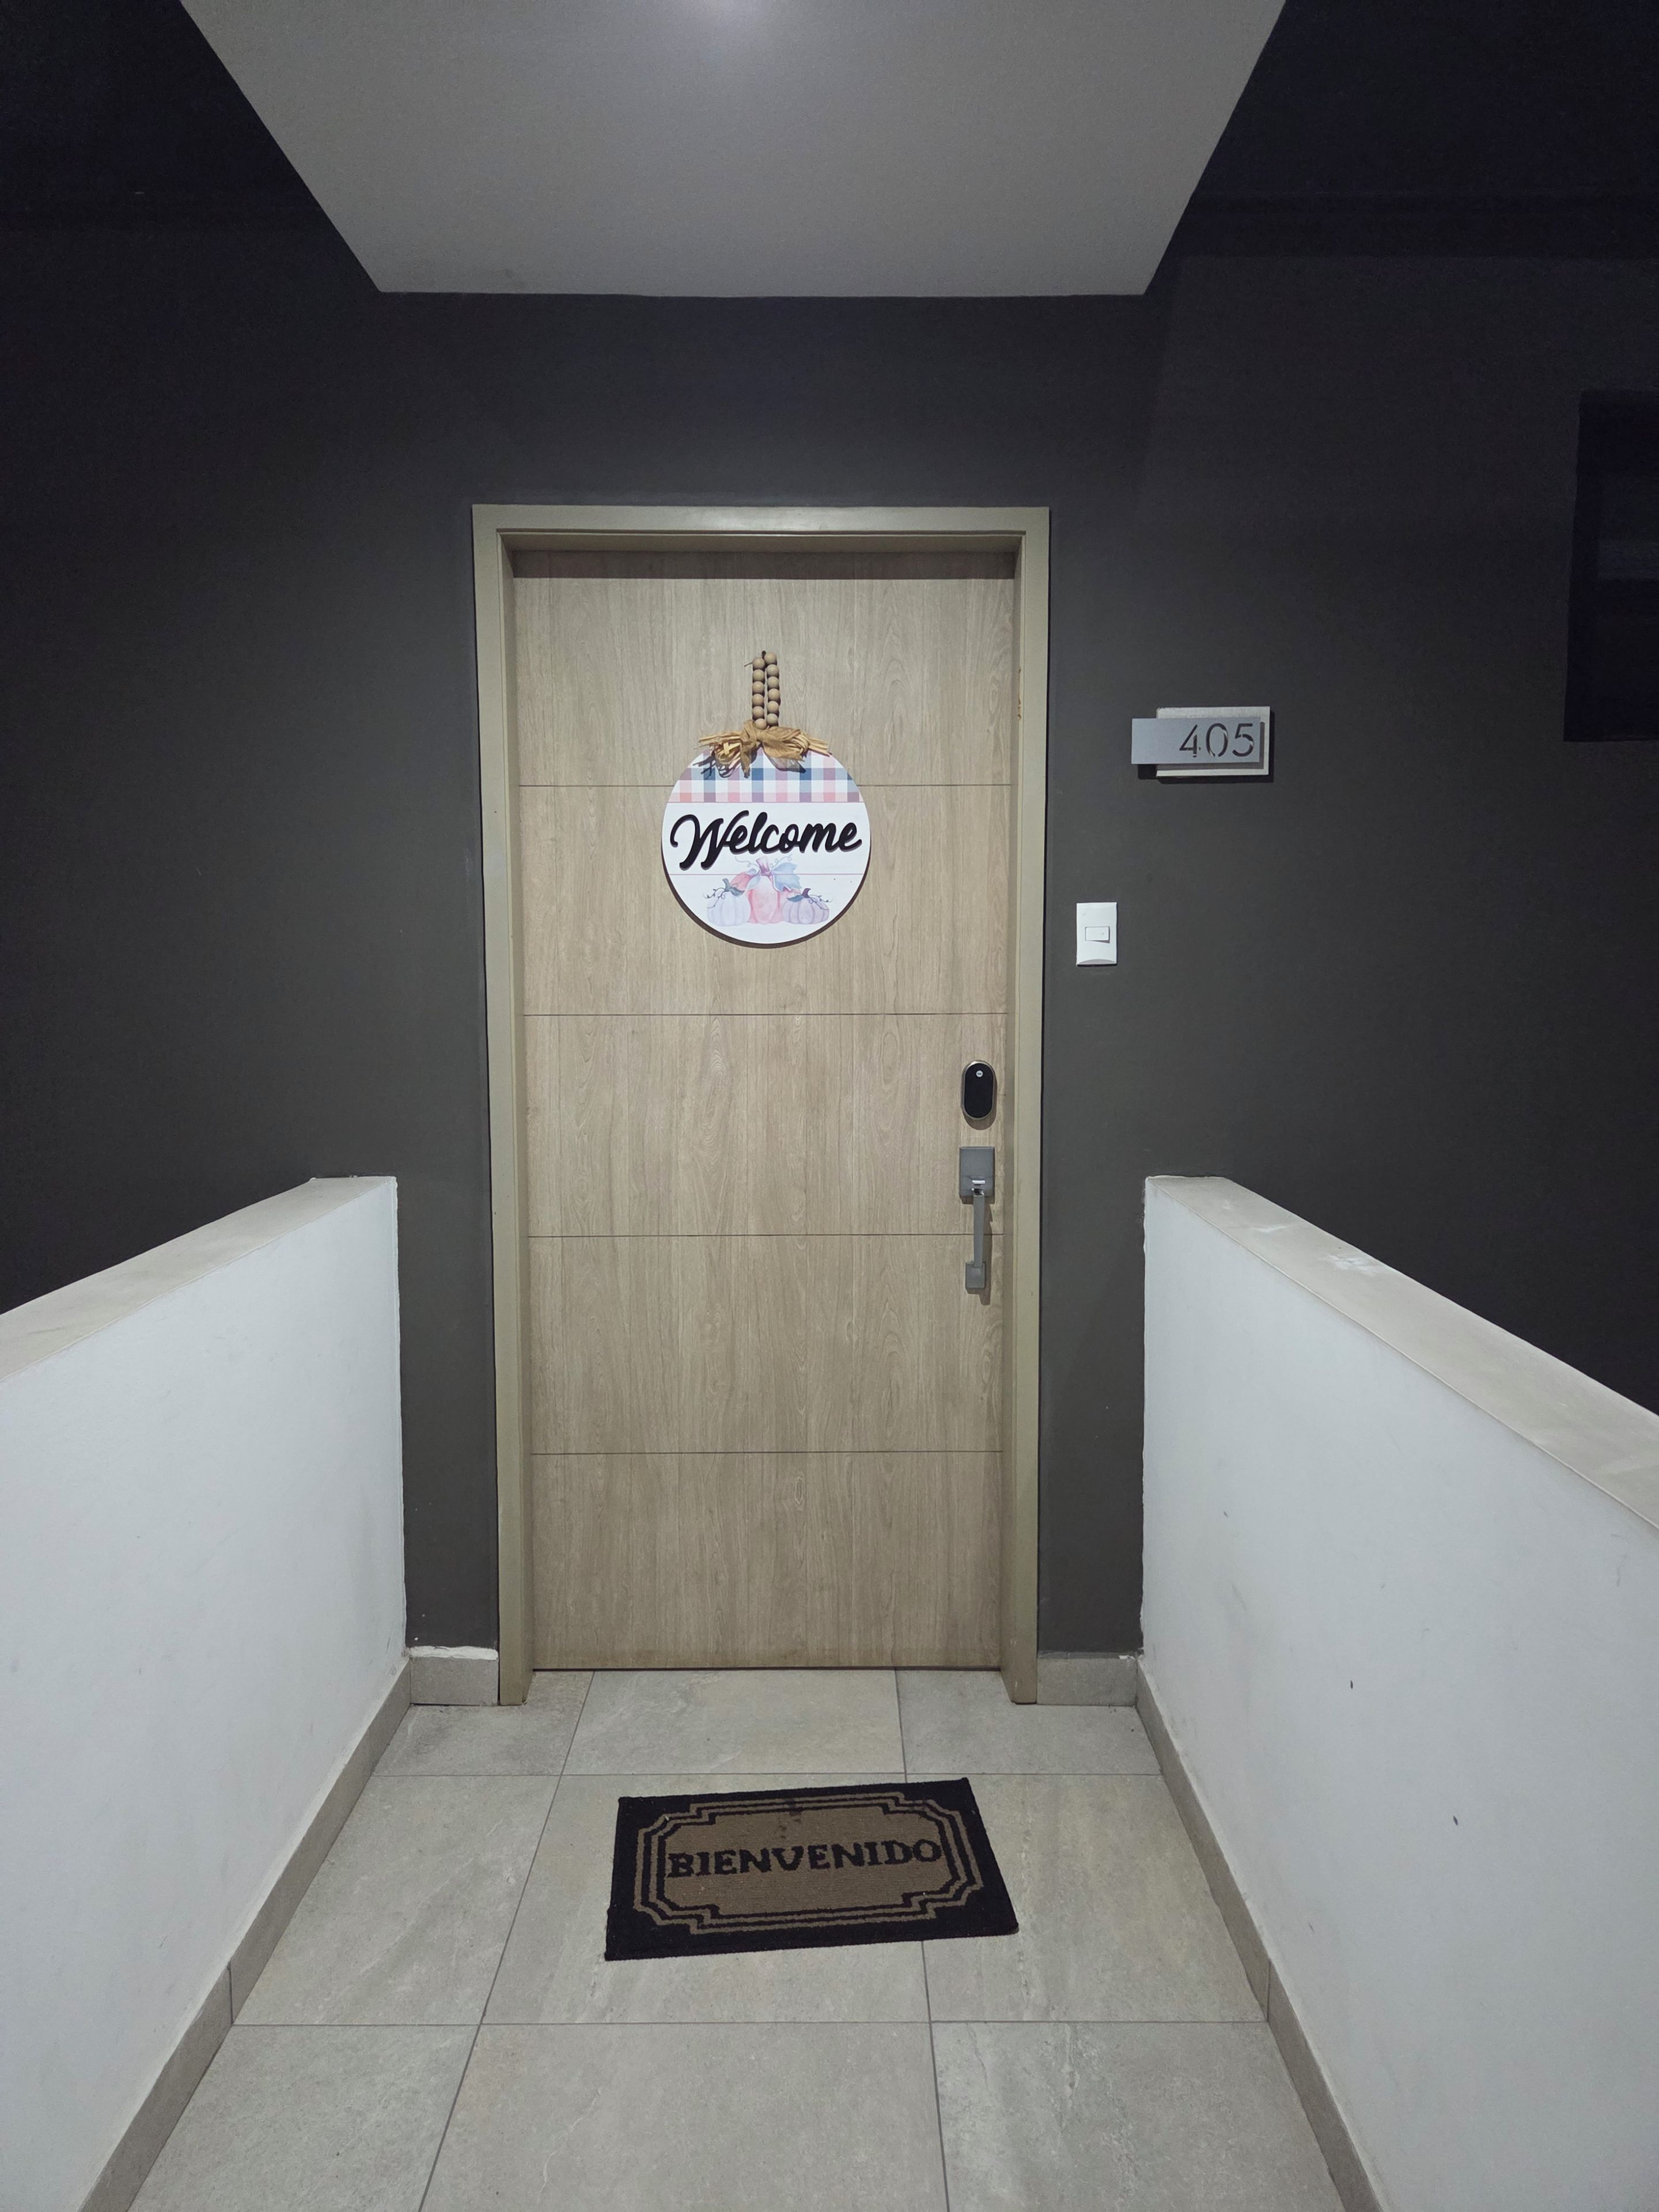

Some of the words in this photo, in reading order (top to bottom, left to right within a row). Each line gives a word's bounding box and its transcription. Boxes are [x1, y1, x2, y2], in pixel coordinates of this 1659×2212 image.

[1179, 723, 1254, 757] 405
[670, 810, 862, 869] Welcome
[667, 1839, 944, 1878] BIENVENIDO
